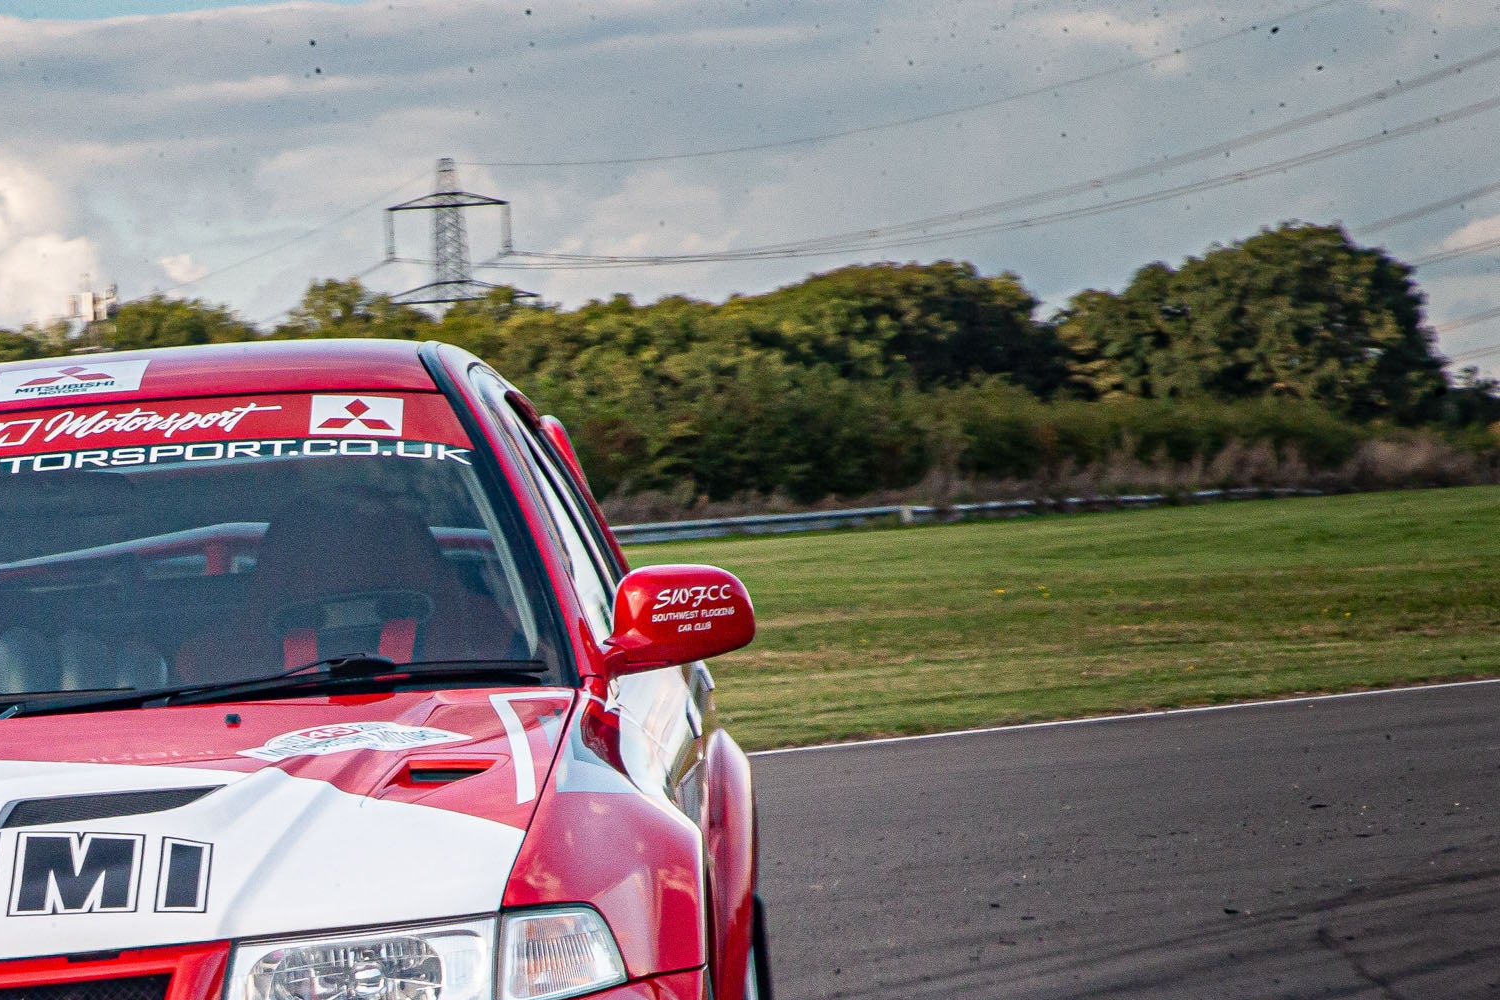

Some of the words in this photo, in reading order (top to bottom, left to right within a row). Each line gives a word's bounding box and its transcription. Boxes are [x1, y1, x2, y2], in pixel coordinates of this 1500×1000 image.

[14, 380, 115, 394] MITSUBISHI
[38, 387, 88, 396] MOTORS
[43, 403, 282, 442] Motorsport
[651, 609, 699, 622] SOUTHWEST
[677, 623, 693, 632] CAR
[694, 621, 712, 631] CLUB
